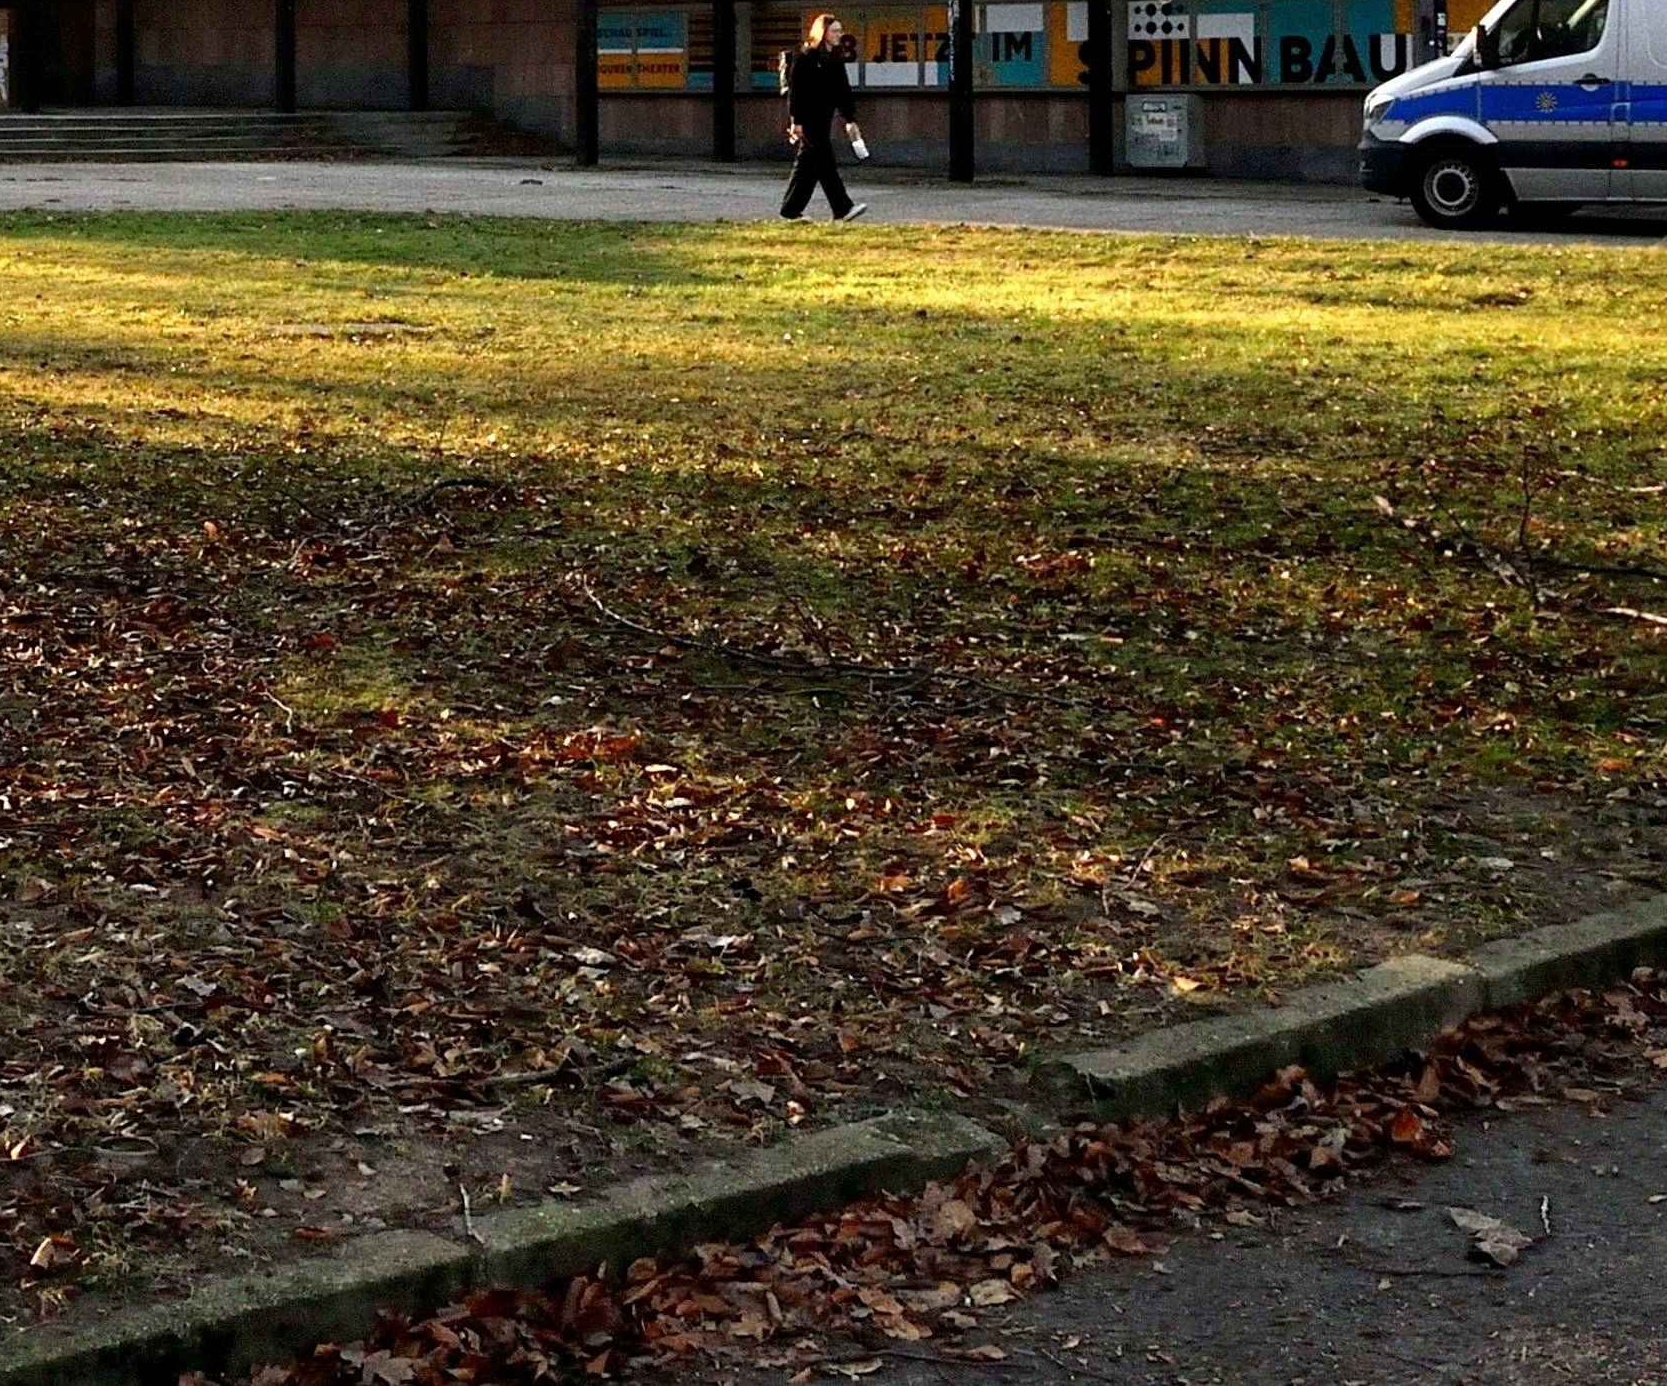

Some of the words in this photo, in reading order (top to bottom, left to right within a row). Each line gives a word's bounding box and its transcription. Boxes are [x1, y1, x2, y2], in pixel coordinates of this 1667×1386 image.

[872, 33, 975, 63] JETZ
[992, 31, 1033, 62] IM
[1279, 34, 1407, 85] BAU
